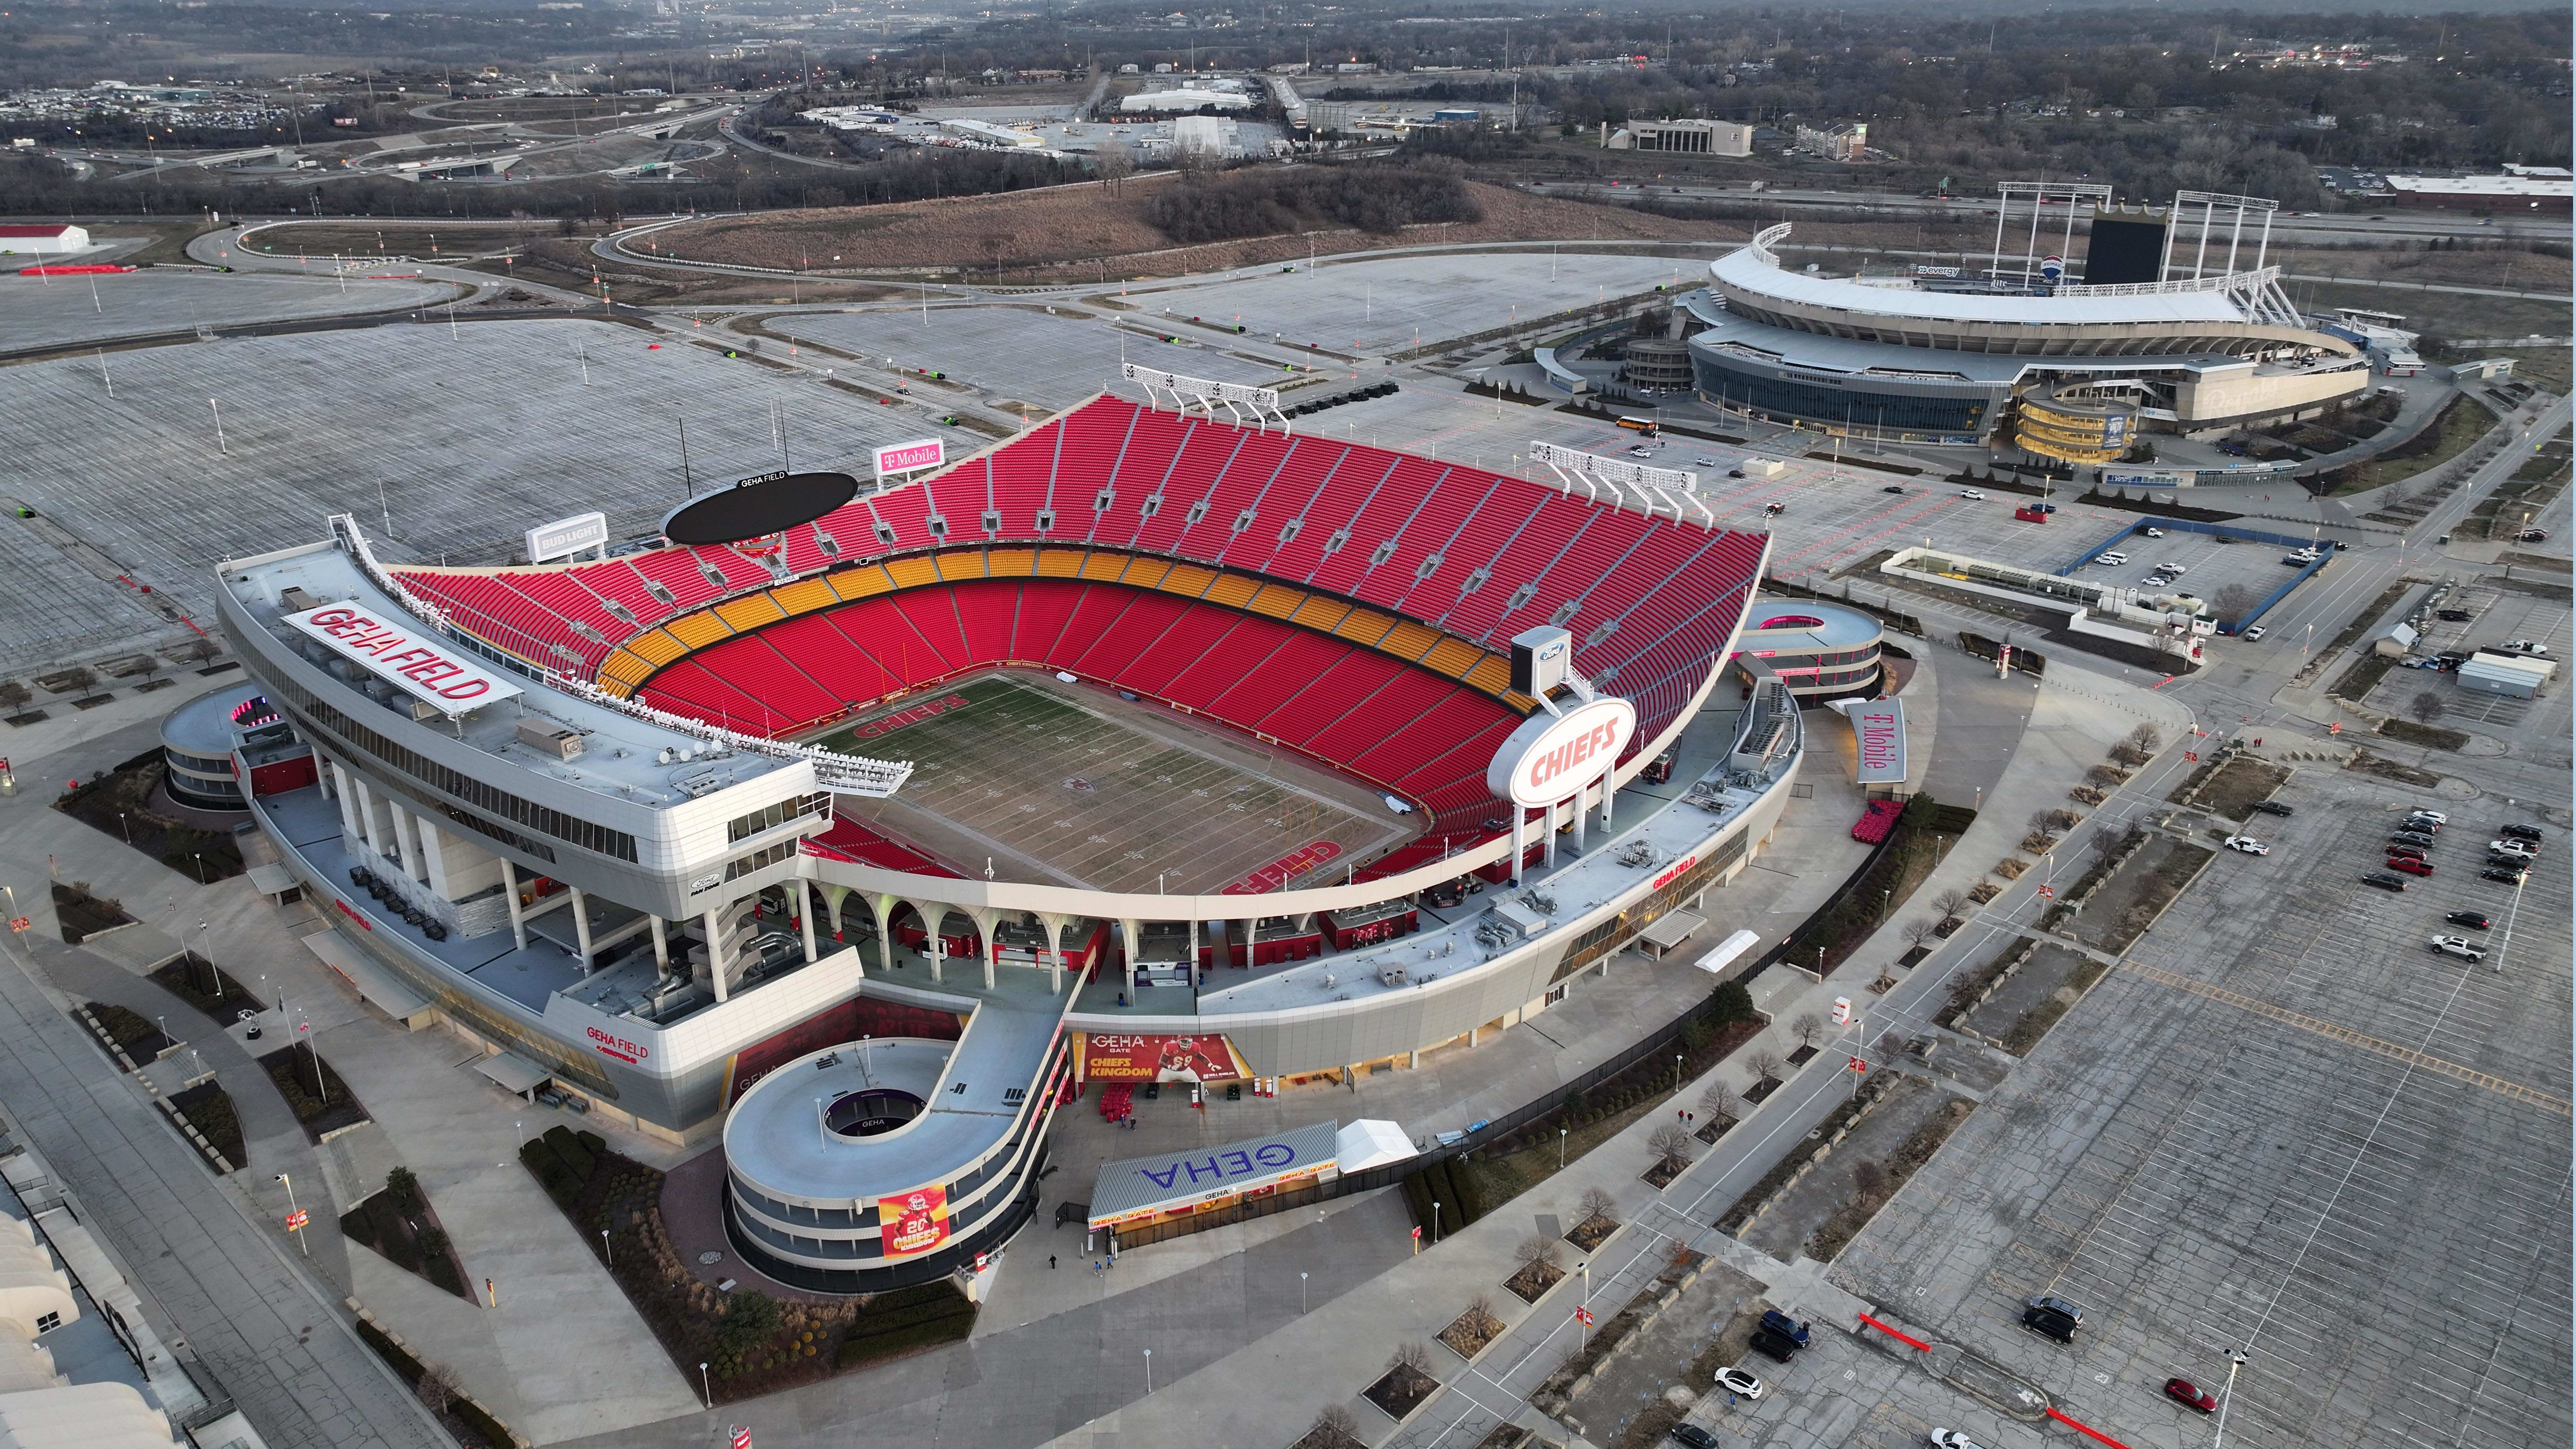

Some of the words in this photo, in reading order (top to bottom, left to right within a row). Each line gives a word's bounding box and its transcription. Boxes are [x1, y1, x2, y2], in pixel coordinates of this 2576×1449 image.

[1927, 267, 1959, 277] evergy
[2356, 322, 2368, 332] MOON
[2204, 378, 2279, 416] Royals
[897, 447, 937, 466] Mobile
[741, 477, 763, 488] GEHA
[764, 471, 785, 483] FIELD
[542, 535, 566, 550] BUD
[567, 524, 598, 542] LIGHT
[778, 576, 795, 584] GEHA
[310, 609, 406, 656] GEHA
[381, 648, 489, 700] FIELD
[1543, 644, 1561, 660] Ford
[1175, 704, 1188, 712] CHIEFS
[853, 694, 970, 739] CHIEFS
[1260, 735, 1274, 743] CHIEFS
[1530, 716, 1619, 787] CHIEFS
[1864, 726, 1896, 769] Mobile
[1019, 804, 1036, 812] 50
[1054, 820, 1070, 828] 40
[1088, 835, 1105, 843] 30
[1123, 851, 1142, 860] 20
[1161, 868, 1180, 876] 10
[1220, 841, 1343, 895] CHIEFS
[1315, 867, 1334, 877] END
[1653, 870, 1675, 889] GEHA
[1675, 856, 1696, 876] FIELD
[587, 1027, 616, 1047] GEHA
[618, 1038, 648, 1058] FIELD
[1090, 1058, 1132, 1067] CHIEFS
[1090, 1068, 1153, 1077] KINGDOM
[862, 1119, 885, 1127] GEHA
[1141, 1144, 1295, 1189] GEHA
[1278, 1170, 1306, 1181] GEHA
[1309, 1162, 1335, 1173] GATE
[1205, 1189, 1229, 1200] GEHA
[1092, 1215, 1122, 1226] GEHA
[1126, 1208, 1155, 1219] GATE
[907, 1217, 928, 1234] 20
[893, 1226, 941, 1250] CHIEFS
[900, 1238, 935, 1251] KINGDOM
